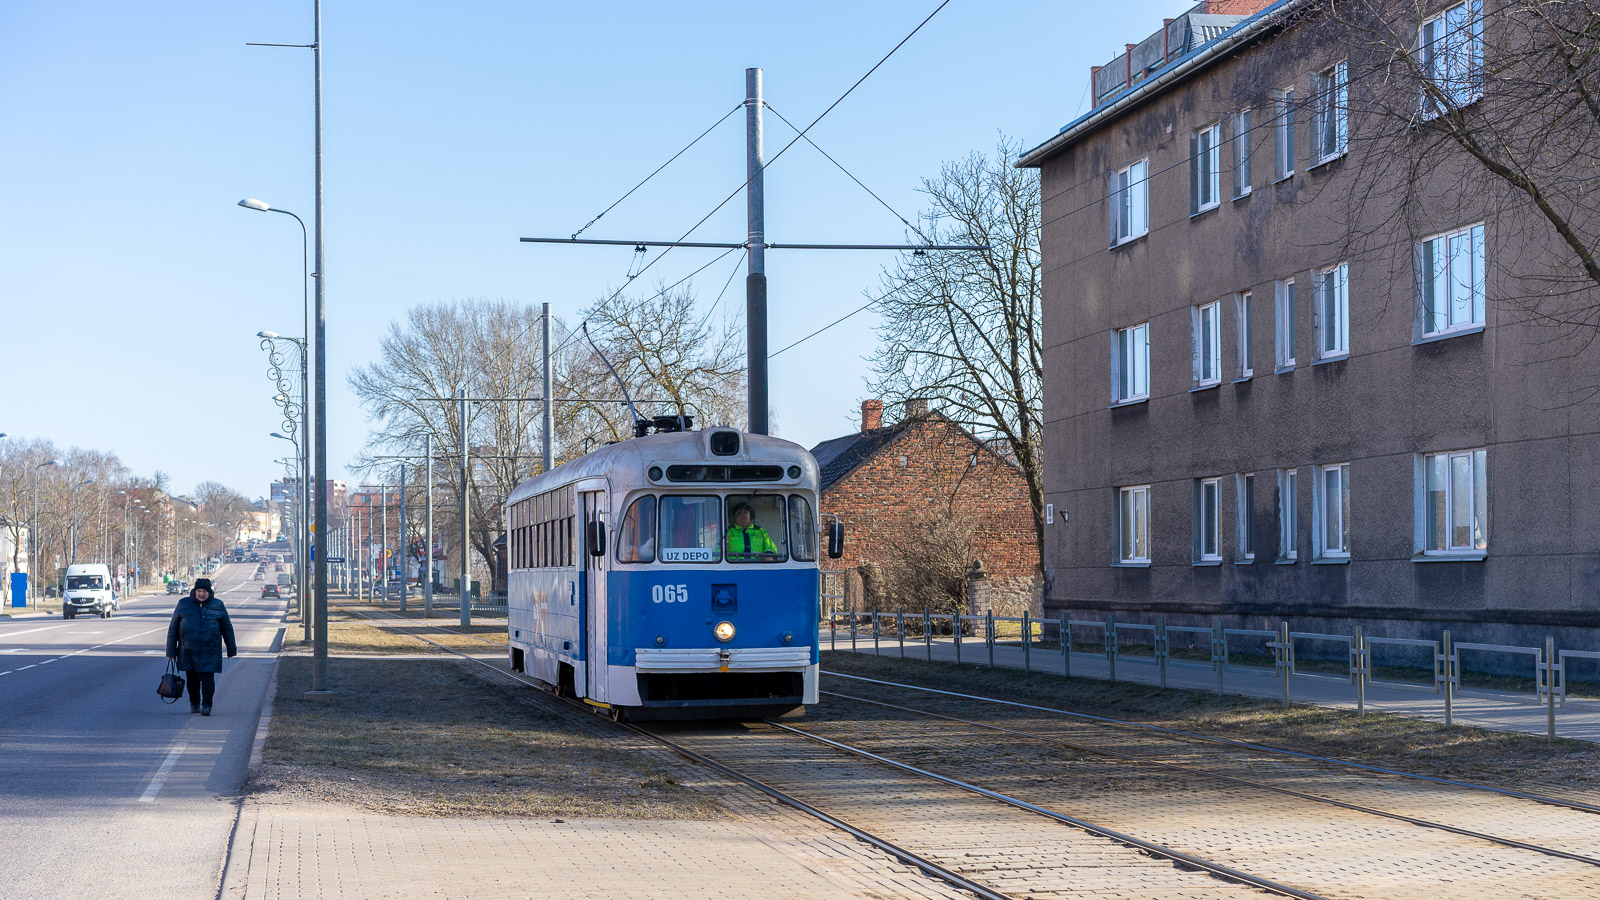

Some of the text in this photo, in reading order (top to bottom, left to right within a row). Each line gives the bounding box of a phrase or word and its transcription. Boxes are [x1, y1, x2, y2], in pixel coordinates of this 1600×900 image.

[666, 551, 709, 560] UZ DEPO
[652, 584, 688, 604] 065
